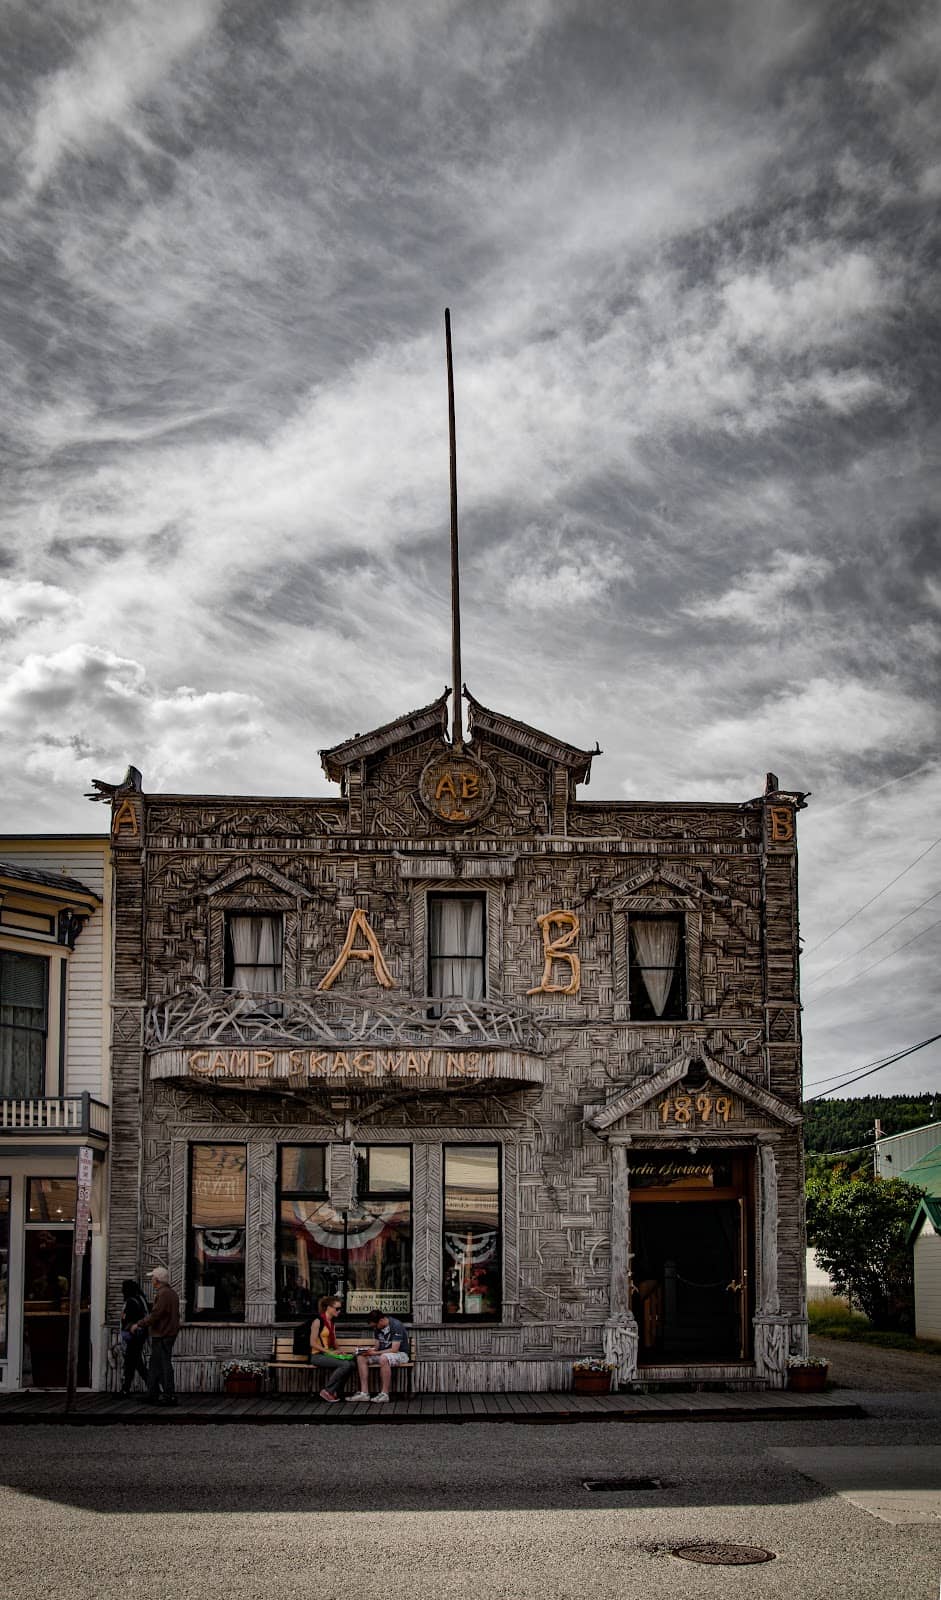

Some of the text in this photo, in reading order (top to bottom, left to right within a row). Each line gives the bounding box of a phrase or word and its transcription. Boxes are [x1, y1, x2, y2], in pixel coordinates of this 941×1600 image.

[113, 800, 138, 836] A
[771, 807, 793, 841] B
[318, 909, 580, 995] A B
[187, 1051, 274, 1073] CAMP
[289, 1050, 433, 1076] SKAGWAY
[658, 1096, 732, 1122] 1899
